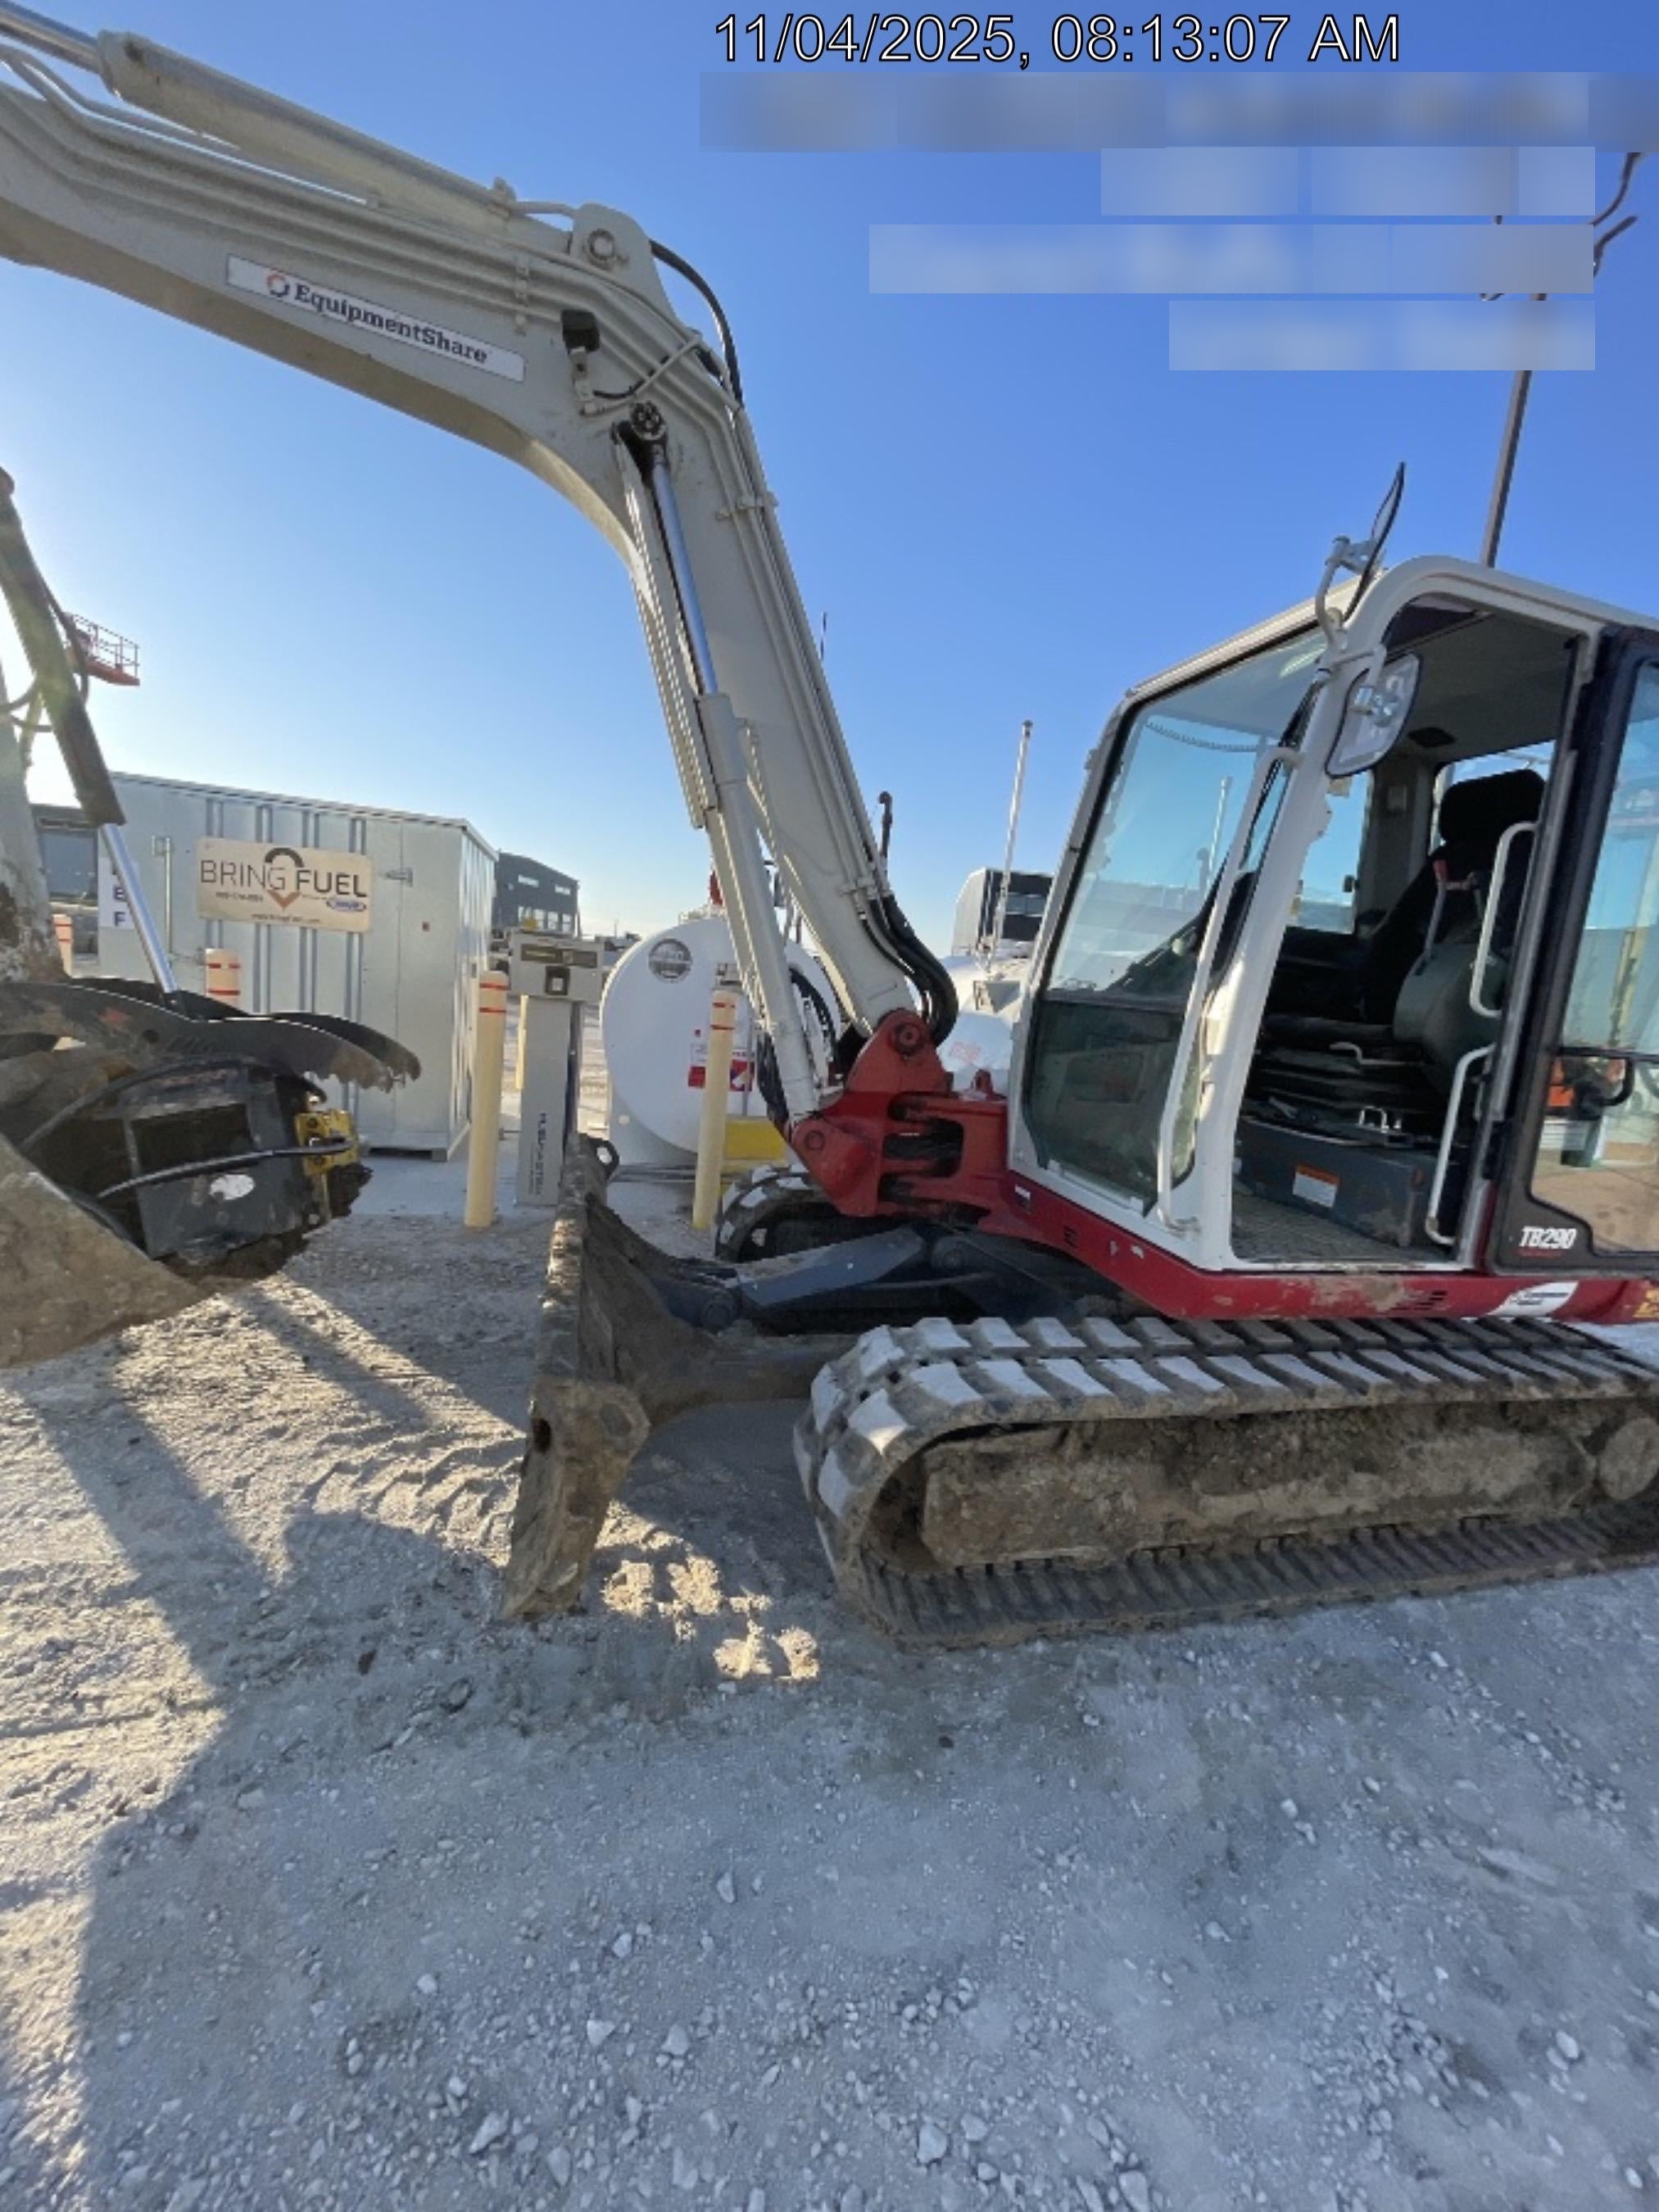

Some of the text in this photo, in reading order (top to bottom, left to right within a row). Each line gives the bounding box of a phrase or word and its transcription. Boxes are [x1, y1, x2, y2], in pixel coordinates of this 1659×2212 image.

[294, 282, 488, 365] EquipmentShare
[200, 859, 287, 891] BRING
[296, 869, 368, 898] FUEL
[1520, 1226, 1576, 1249] TB290
